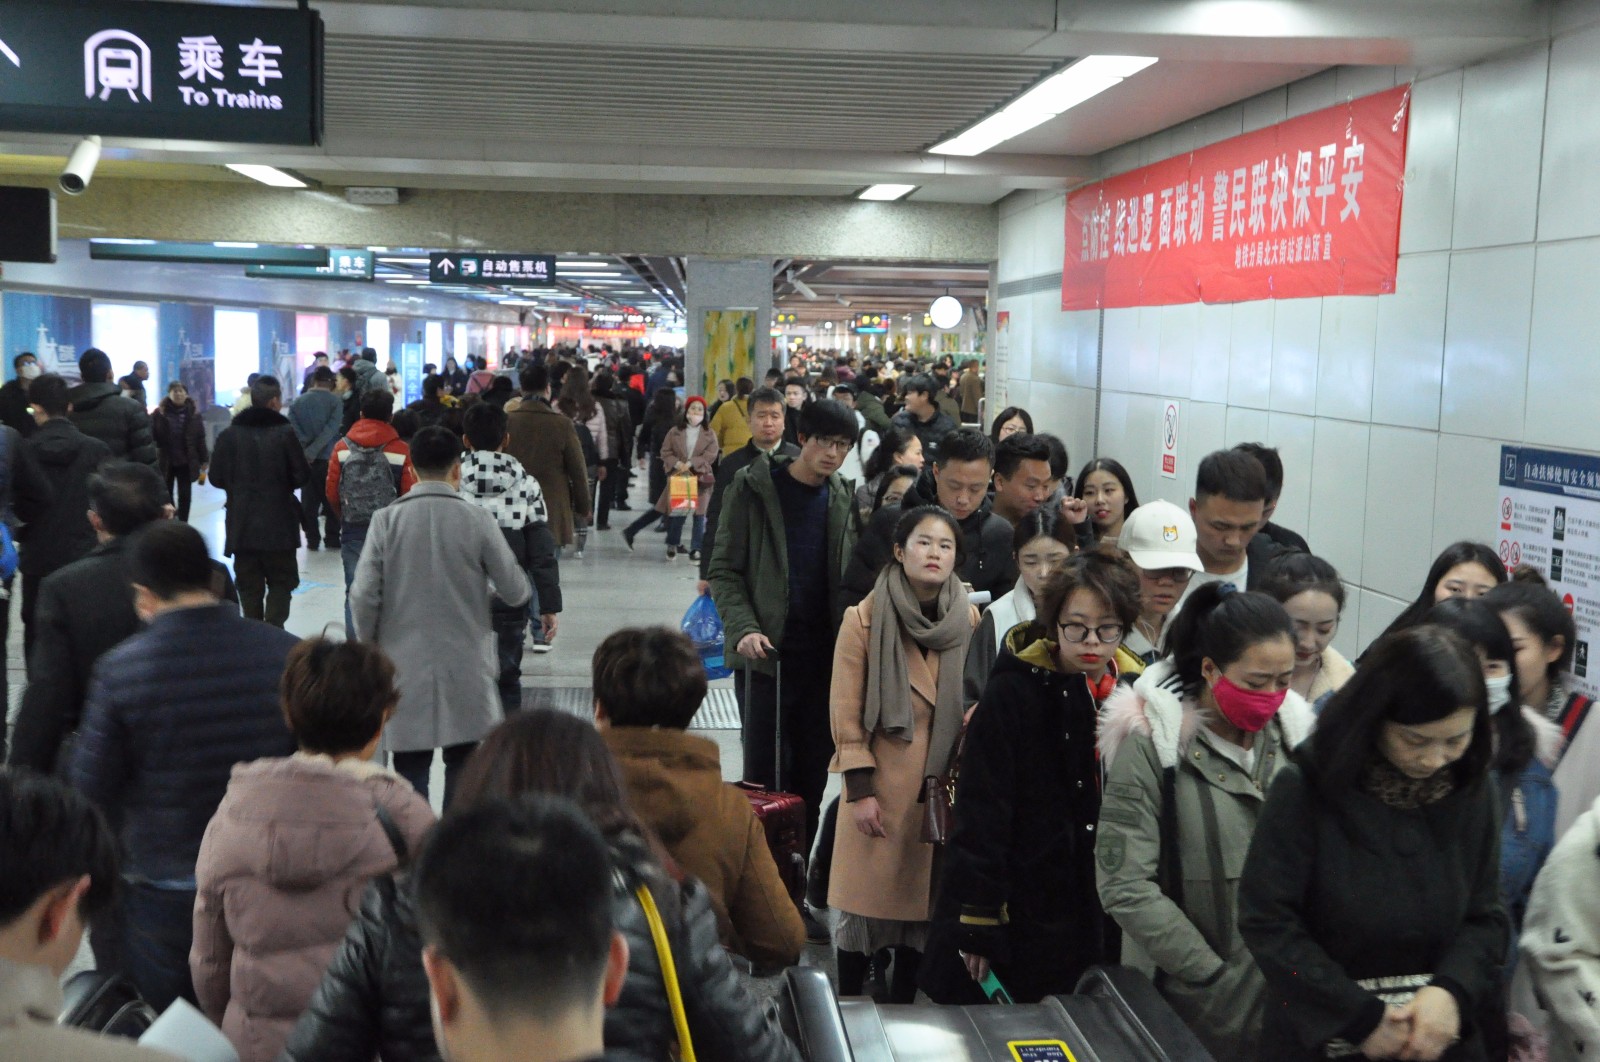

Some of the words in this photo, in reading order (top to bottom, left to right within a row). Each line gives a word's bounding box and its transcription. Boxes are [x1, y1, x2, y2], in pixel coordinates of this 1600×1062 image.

[177, 34, 283, 87] 乘车
[177, 85, 210, 107] To
[211, 86, 284, 111] Trains
[1159, 175, 1204, 250] 面联动
[1211, 135, 1365, 242] 警民联袂保平安
[482, 259, 548, 273] 自动售票机
